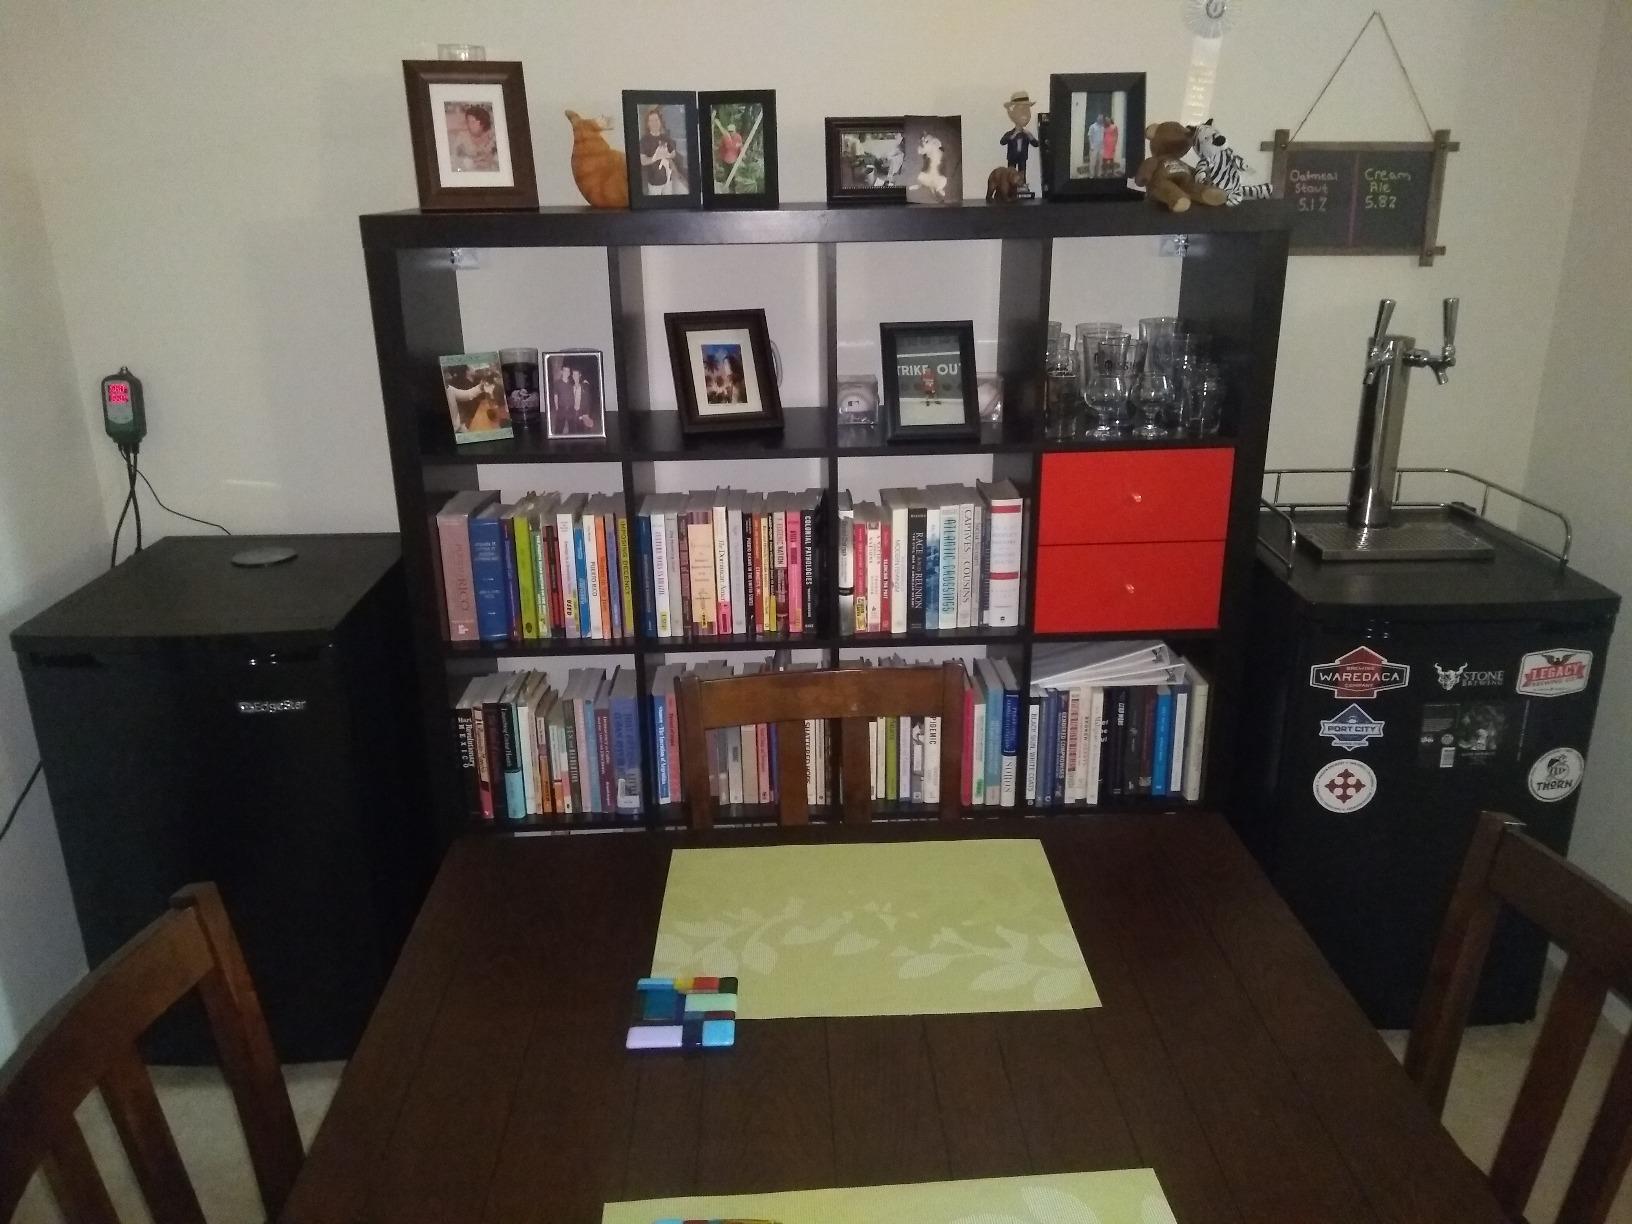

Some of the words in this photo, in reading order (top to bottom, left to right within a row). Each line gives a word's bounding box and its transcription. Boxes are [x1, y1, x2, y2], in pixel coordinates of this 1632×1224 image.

[1289, 169, 1338, 182] Oatmeal
[1364, 168, 1412, 182] Cream
[1295, 182, 1328, 194] Stout
[1370, 182, 1391, 193] Ale
[897, 364, 929, 376] TRIKE
[937, 363, 961, 376] OU
[620, 520, 628, 558] IMPOSING
[804, 515, 812, 545] COLONIAL
[944, 519, 956, 561] ATLANTIC
[964, 509, 972, 552] CAPTIVES
[915, 532, 923, 554] RACE
[777, 545, 785, 565] NATION
[805, 546, 813, 585] PATHOLOGIES
[915, 573, 923, 609] REUNION
[942, 565, 955, 613] CROSSINGS
[1319, 671, 1400, 682] WAREDACA
[1462, 671, 1505, 681] STONE
[1532, 663, 1580, 680] LEGACY
[929, 716, 937, 745] PIDEMIC
[458, 724, 469, 768] MEXICO
[465, 724, 475, 767] Revolutionary
[1536, 779, 1574, 791] THORN
